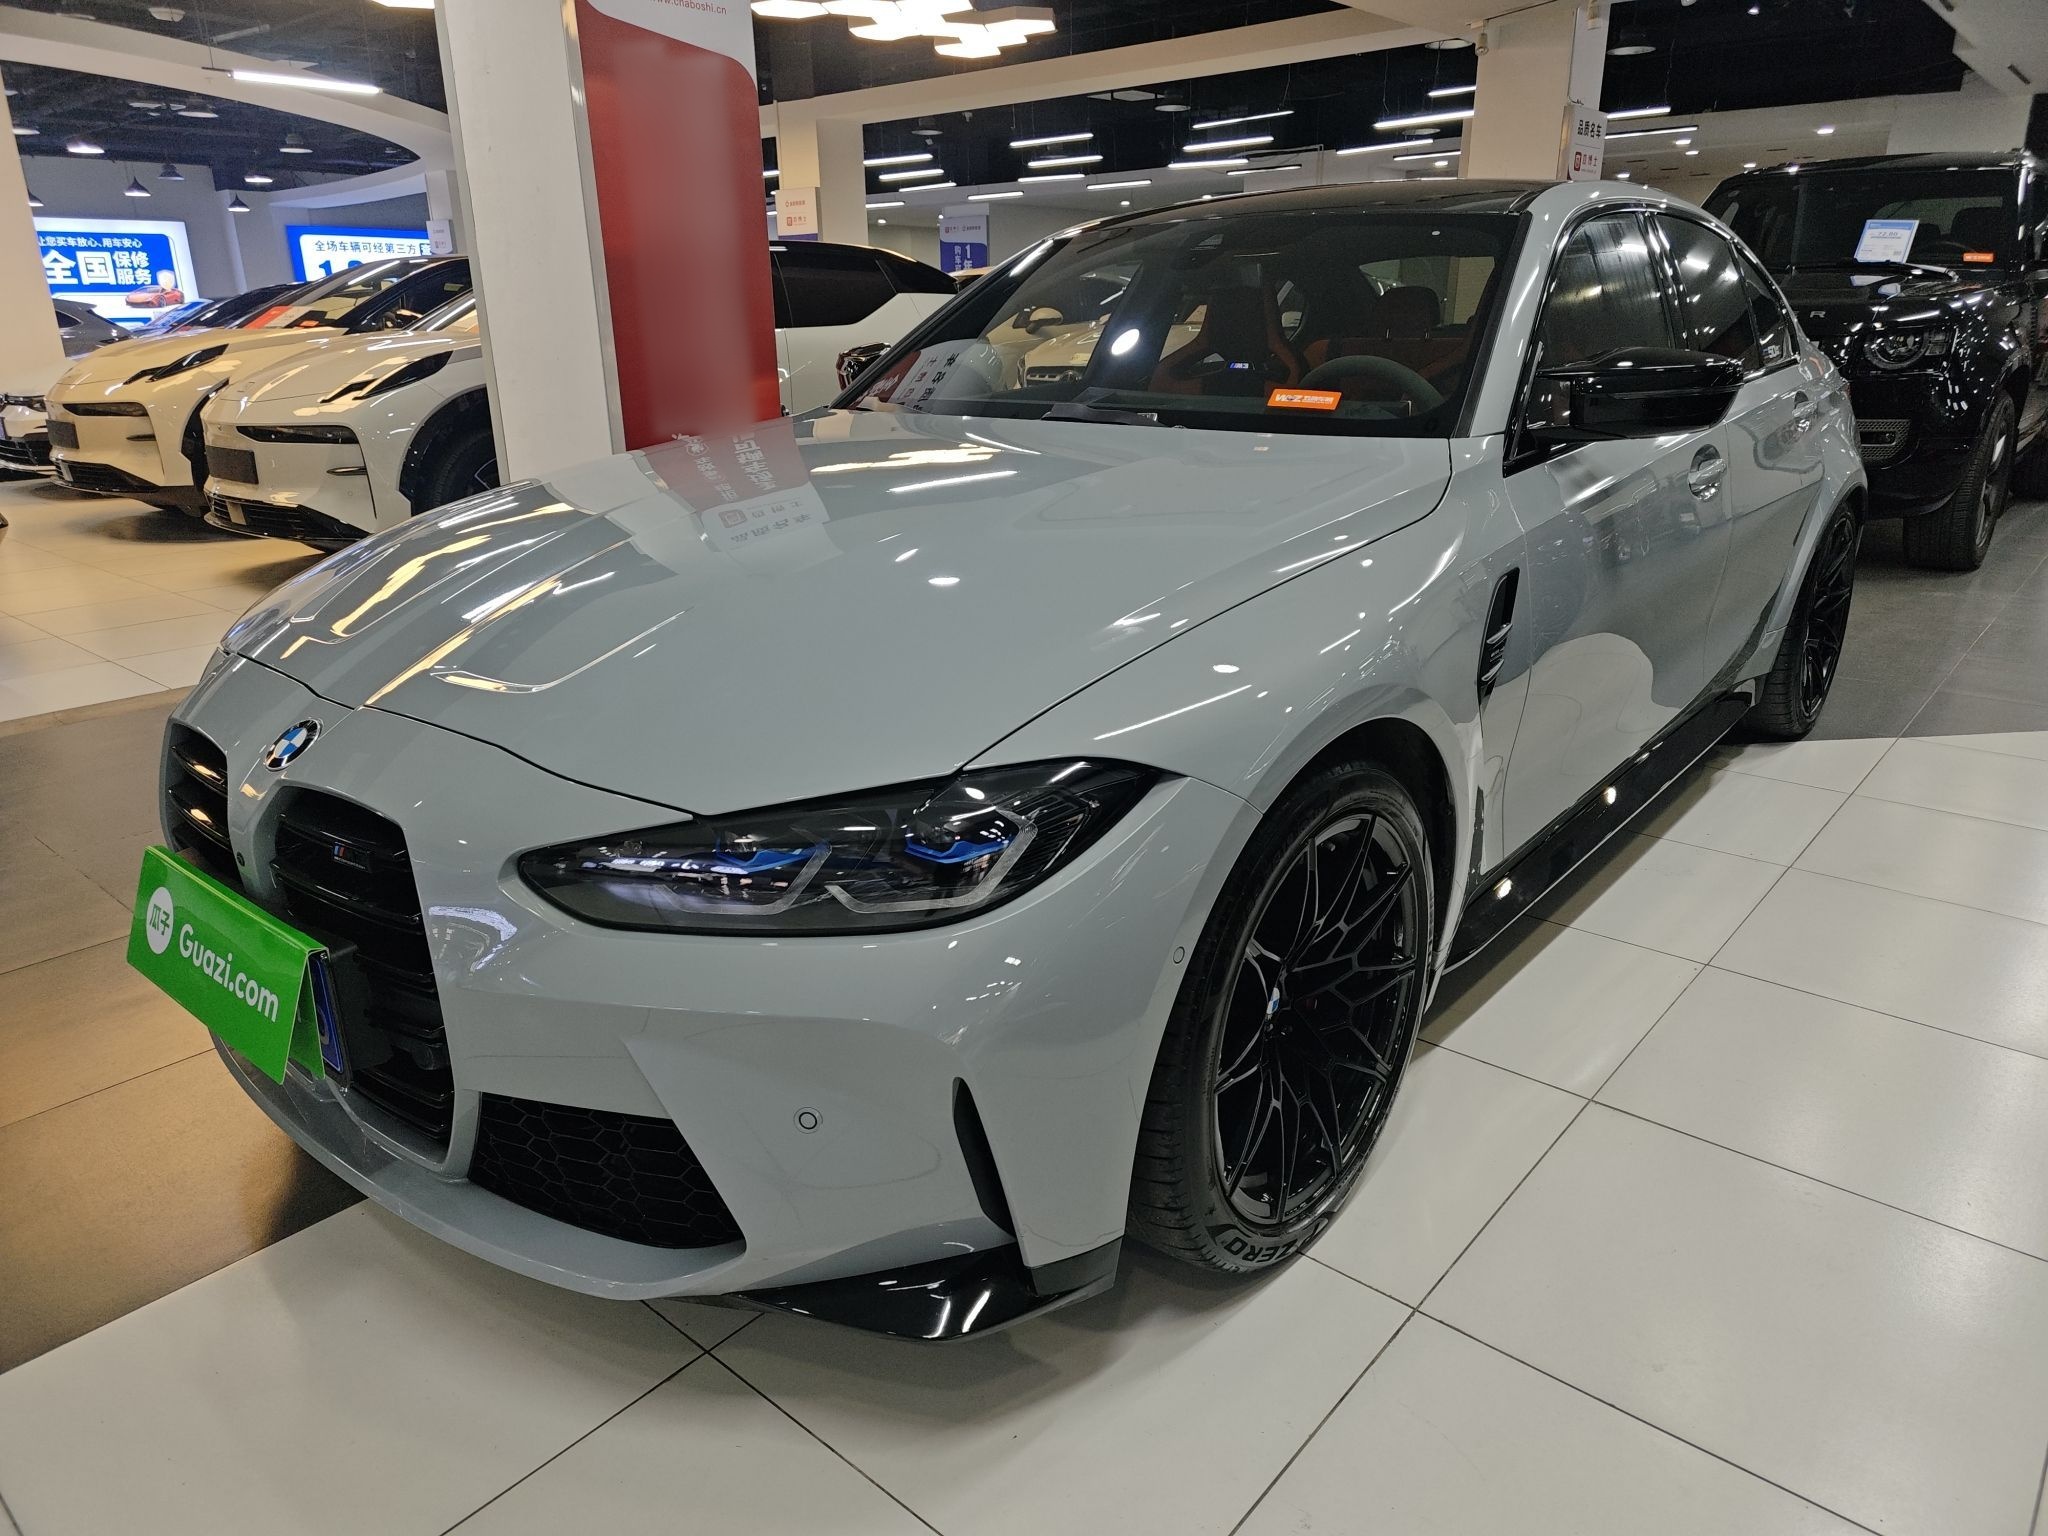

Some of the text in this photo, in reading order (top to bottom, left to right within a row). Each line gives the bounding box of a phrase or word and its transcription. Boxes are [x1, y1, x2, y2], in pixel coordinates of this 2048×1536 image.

[649, 0, 727, 15] w.chaboshi.cn
[1577, 119, 1602, 139] 品质名车
[314, 239, 417, 255] 全场车辆可经第三方
[42, 249, 117, 285] 全国
[112, 250, 150, 268] 保修
[116, 268, 152, 285] 服务
[149, 904, 170, 936] 瓜子
[179, 923, 279, 1023] Guazi.com
[1223, 1237, 1299, 1264] ZERO
